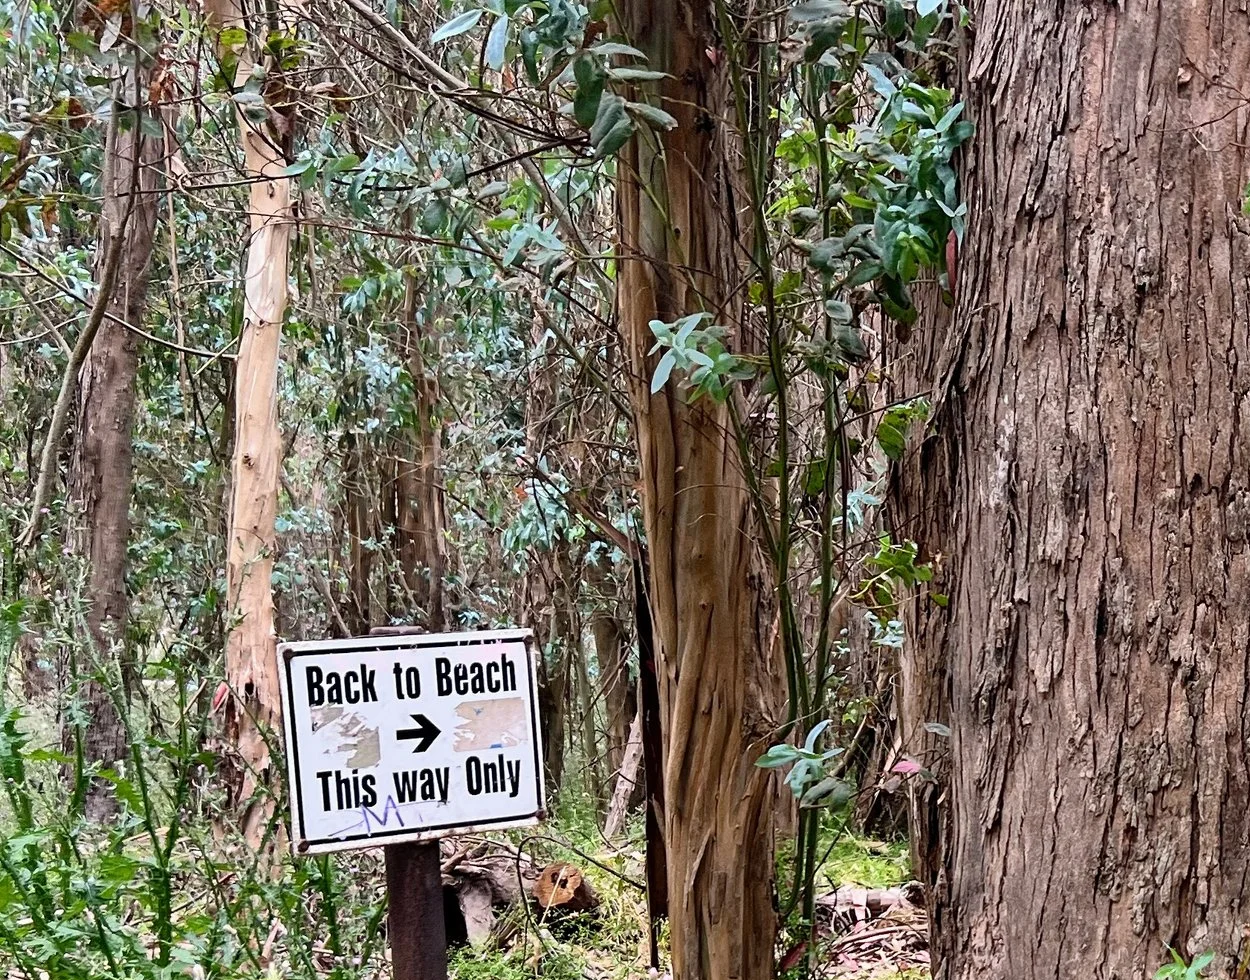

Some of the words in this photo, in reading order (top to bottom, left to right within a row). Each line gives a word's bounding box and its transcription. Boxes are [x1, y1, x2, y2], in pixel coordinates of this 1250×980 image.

[305, 664, 378, 706] Back
[393, 662, 421, 700] to
[435, 653, 517, 697] Beach
[317, 769, 377, 812] This
[393, 767, 450, 808] way
[465, 754, 521, 798] Only
